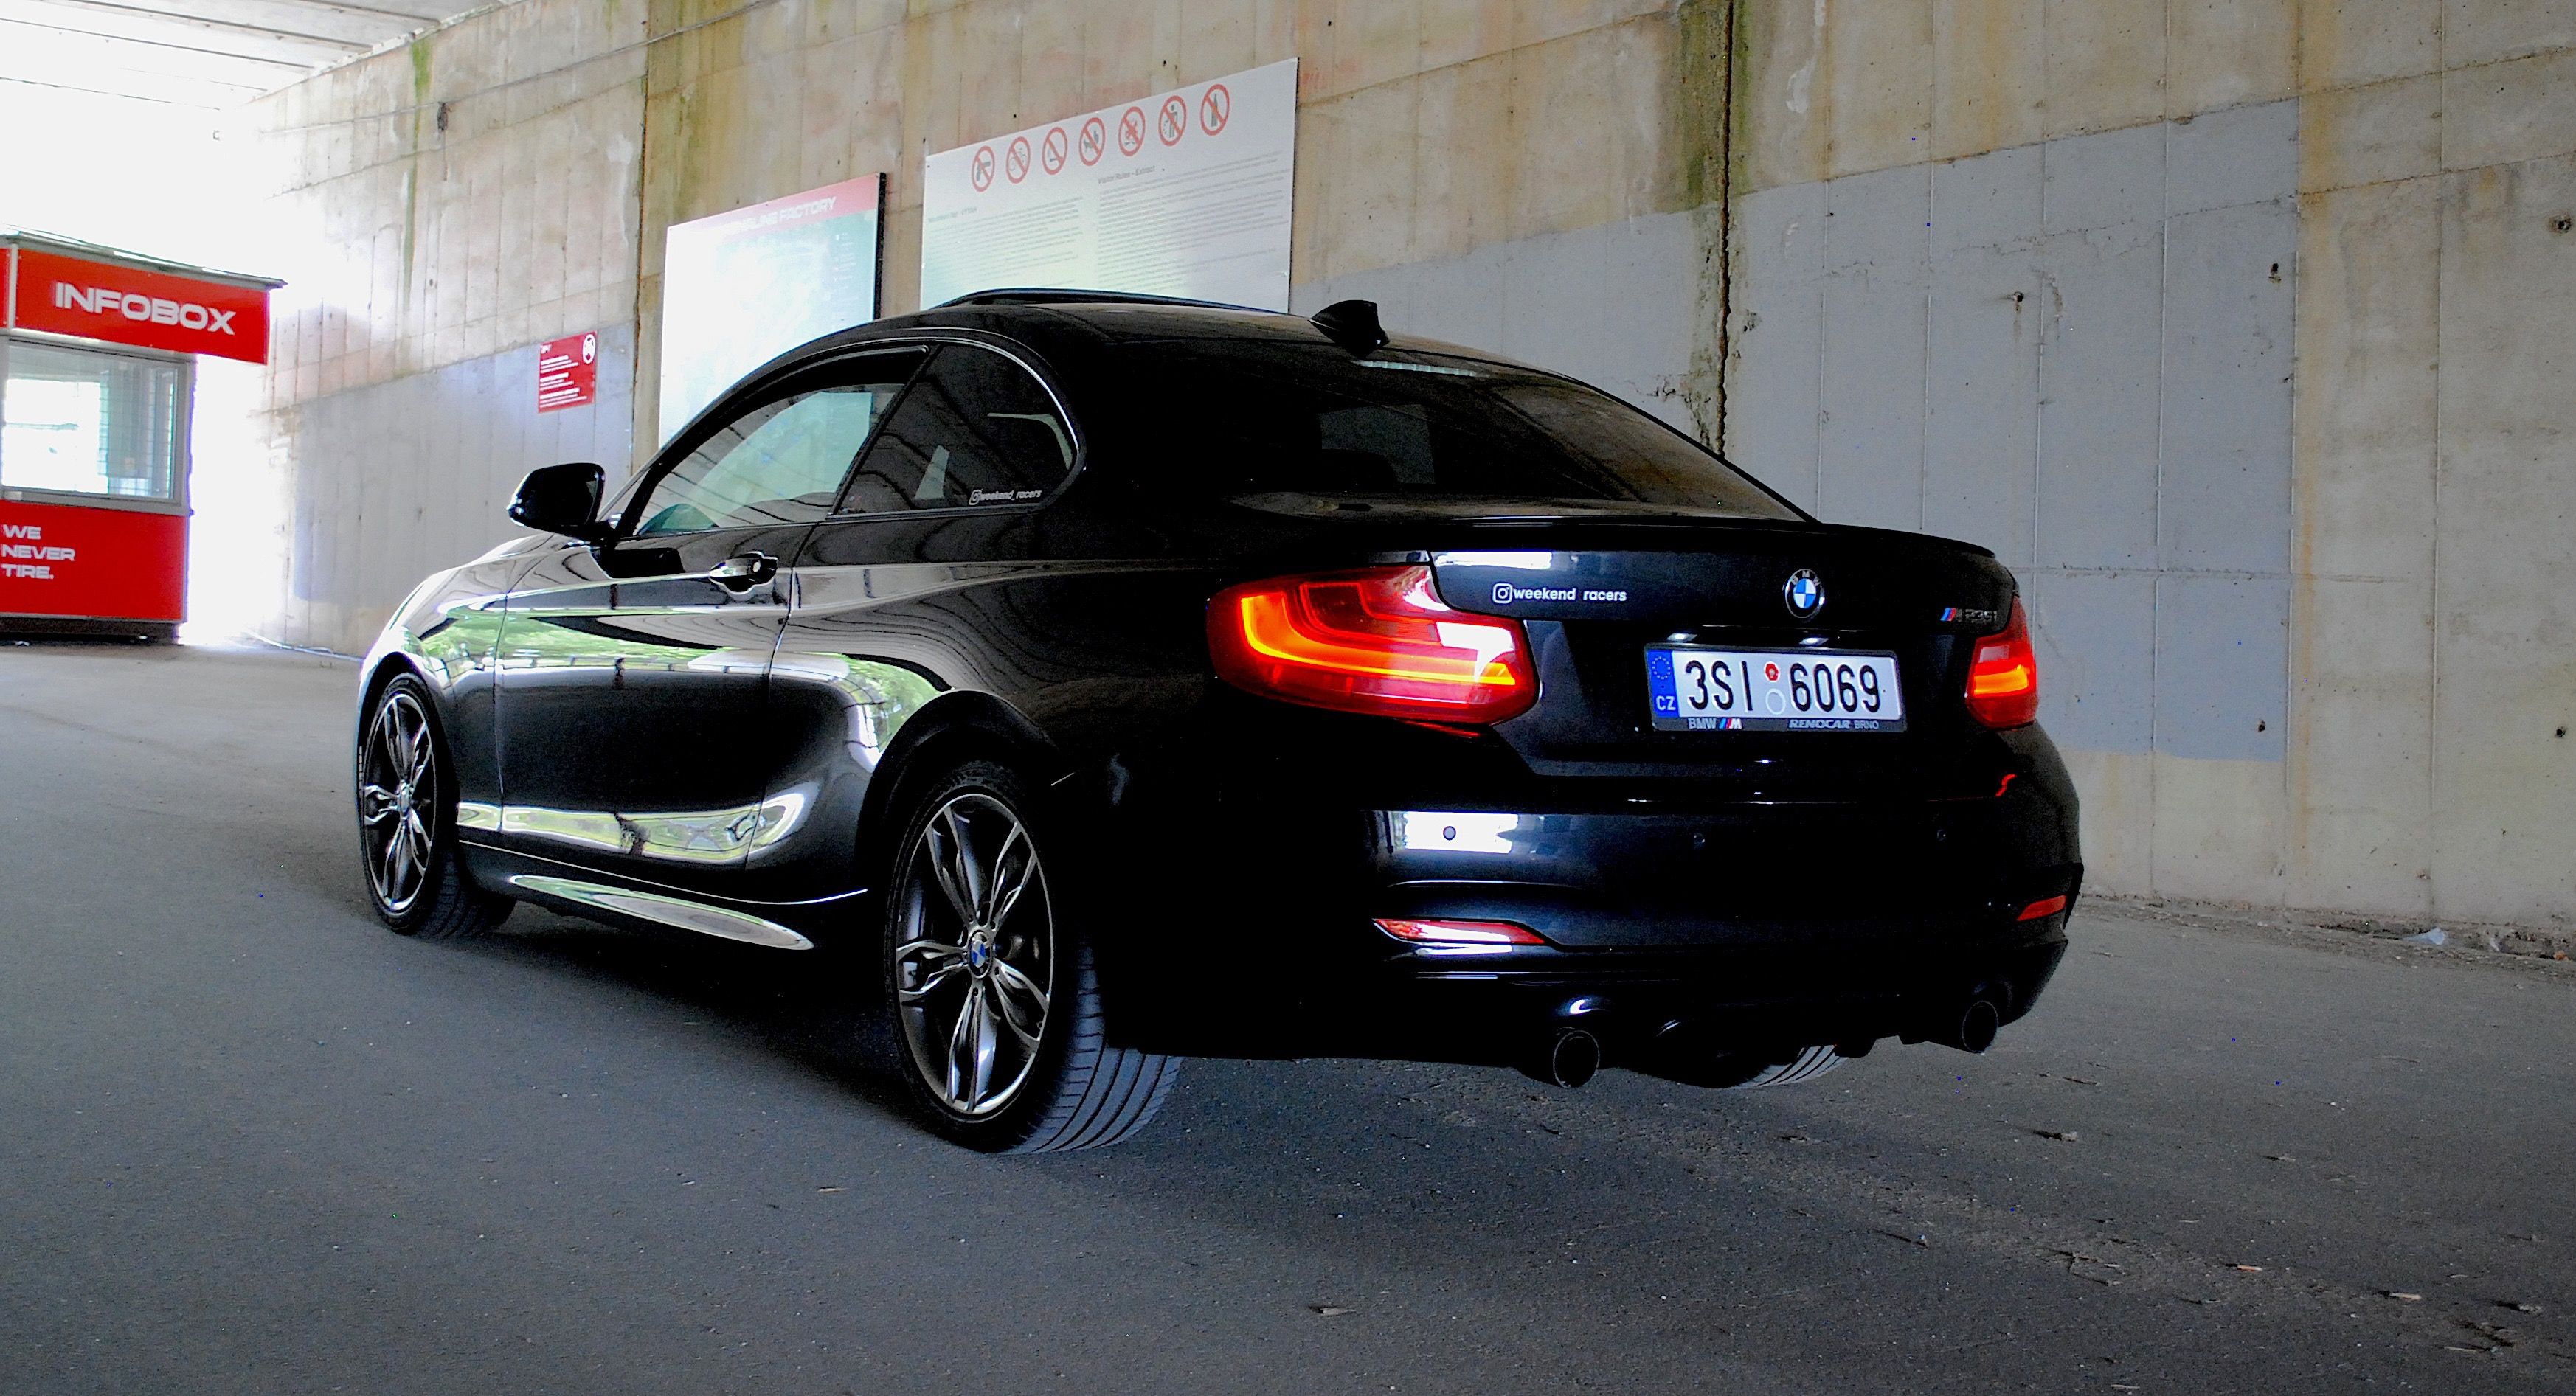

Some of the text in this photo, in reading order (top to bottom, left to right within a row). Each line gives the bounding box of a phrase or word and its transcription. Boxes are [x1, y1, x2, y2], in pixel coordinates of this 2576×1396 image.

[780, 196, 837, 222] FACTORY
[55, 282, 237, 336] INFOBOX
[2, 524, 42, 540] WE
[1, 544, 76, 561] NEVER
[1, 563, 54, 580] TIRE.
[1685, 660, 1880, 713] 3SI 6069
[1655, 695, 1676, 712] CZ
[1687, 718, 1717, 729] BMW
[1788, 719, 1880, 729] RENOCAR BRNO
